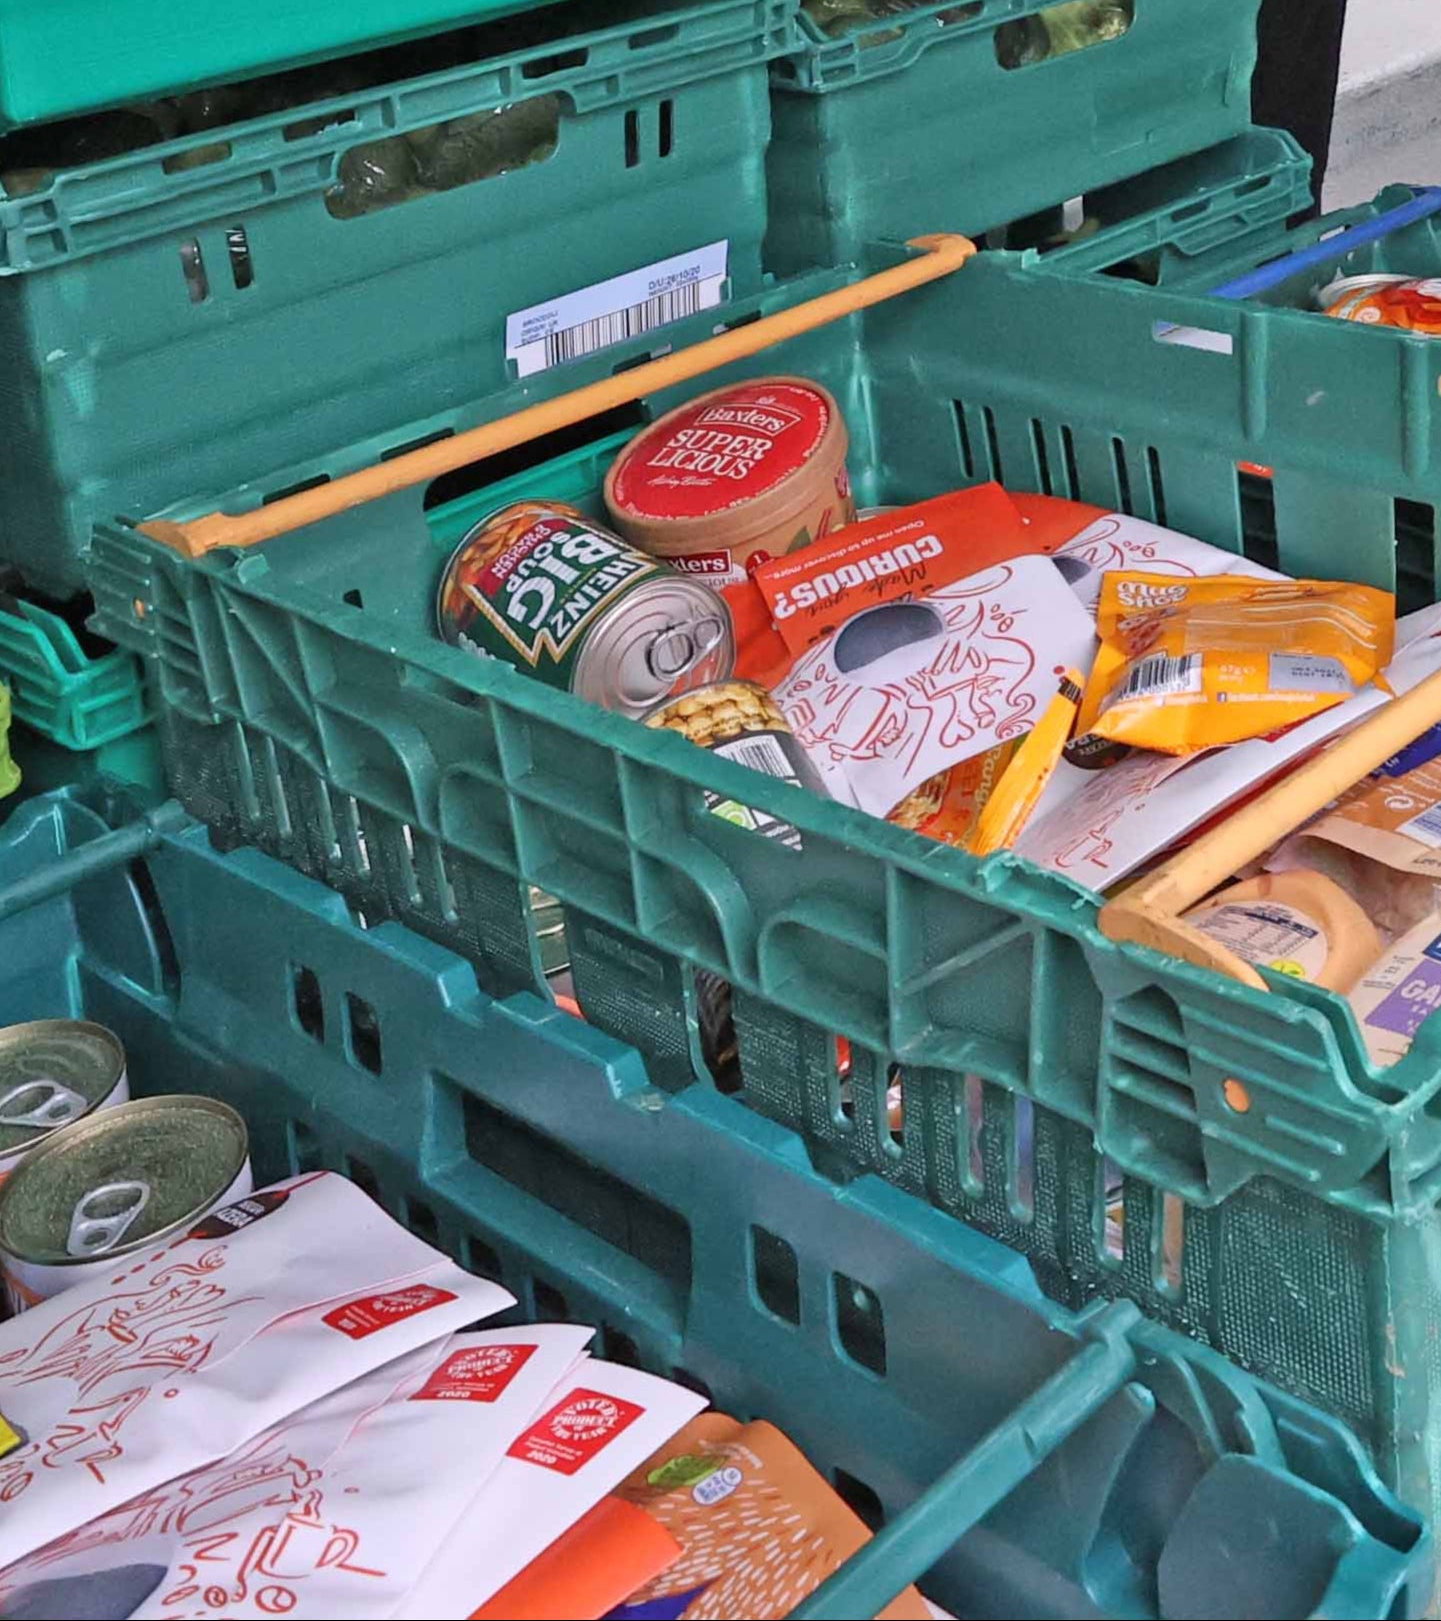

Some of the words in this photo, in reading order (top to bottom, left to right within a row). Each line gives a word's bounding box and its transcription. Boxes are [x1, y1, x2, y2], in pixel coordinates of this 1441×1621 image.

[704, 407, 785, 432] Baxters
[646, 447, 757, 480] LICIOUS
[667, 429, 773, 461] SUPER
[506, 530, 572, 593] SOUP
[506, 532, 617, 630] BIG
[773, 534, 944, 620] CURIOUS?
[549, 559, 636, 638] HEINZ
[549, 1415, 616, 1429] PRODUCT
